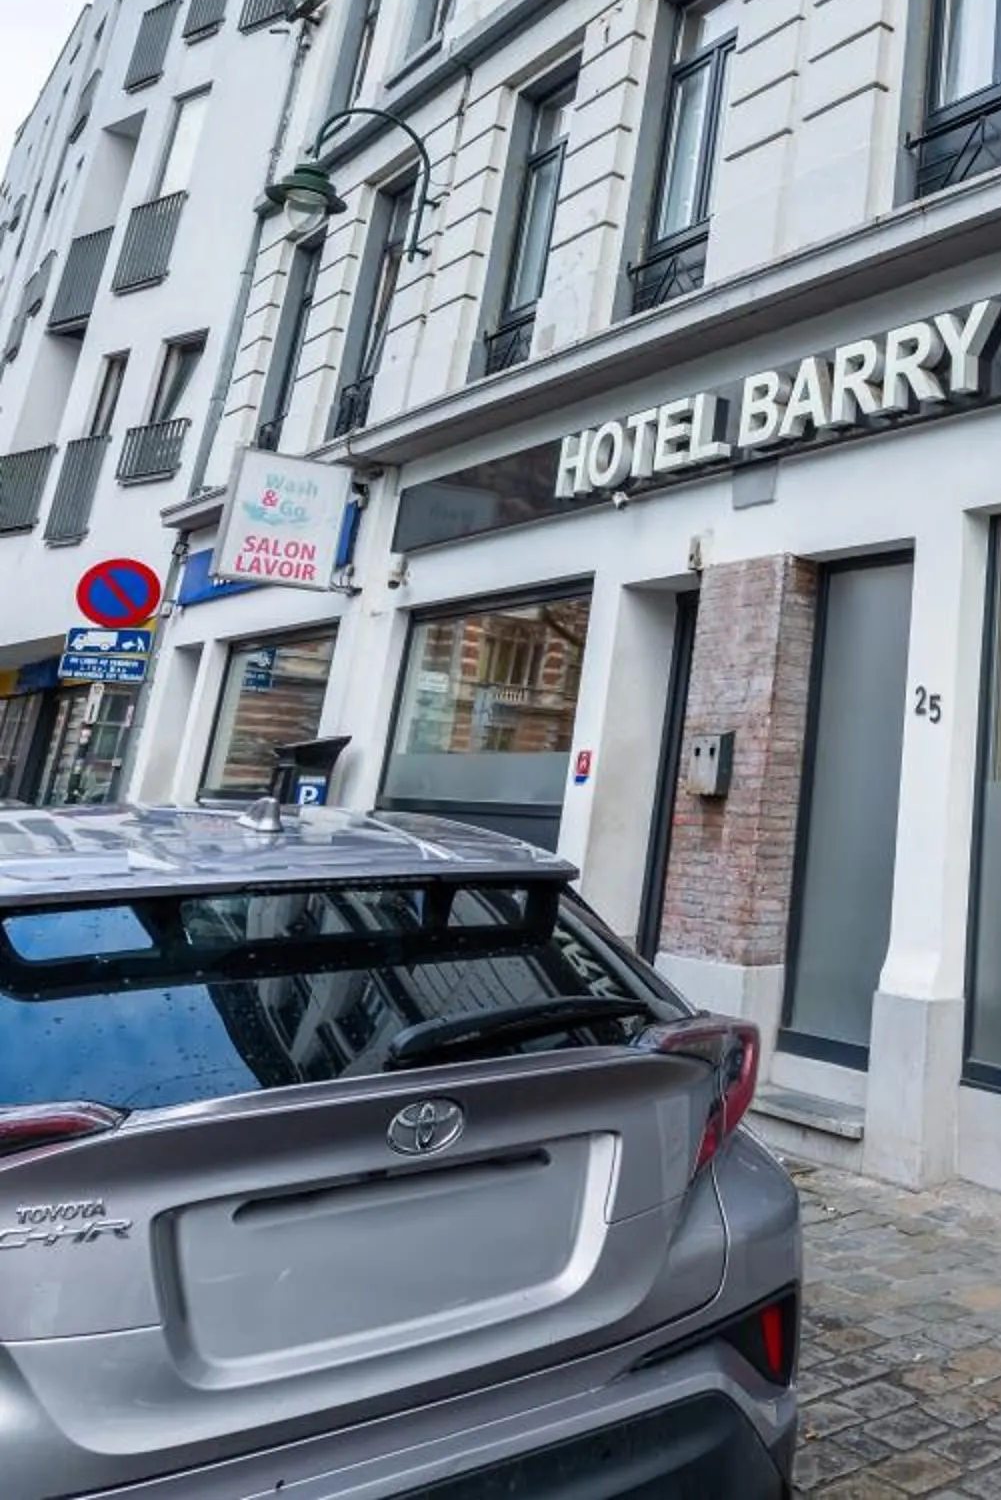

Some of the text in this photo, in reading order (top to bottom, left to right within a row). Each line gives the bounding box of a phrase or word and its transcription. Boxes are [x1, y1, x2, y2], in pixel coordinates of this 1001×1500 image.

[554, 392, 732, 499] HOTEL
[265, 473, 318, 497] Wash
[262, 489, 307, 517] & Go
[243, 535, 316, 560] SALON
[235, 555, 316, 581] LAVOIR
[915, 685, 941, 724] 25
[16, 1198, 107, 1225] TOYOTA
